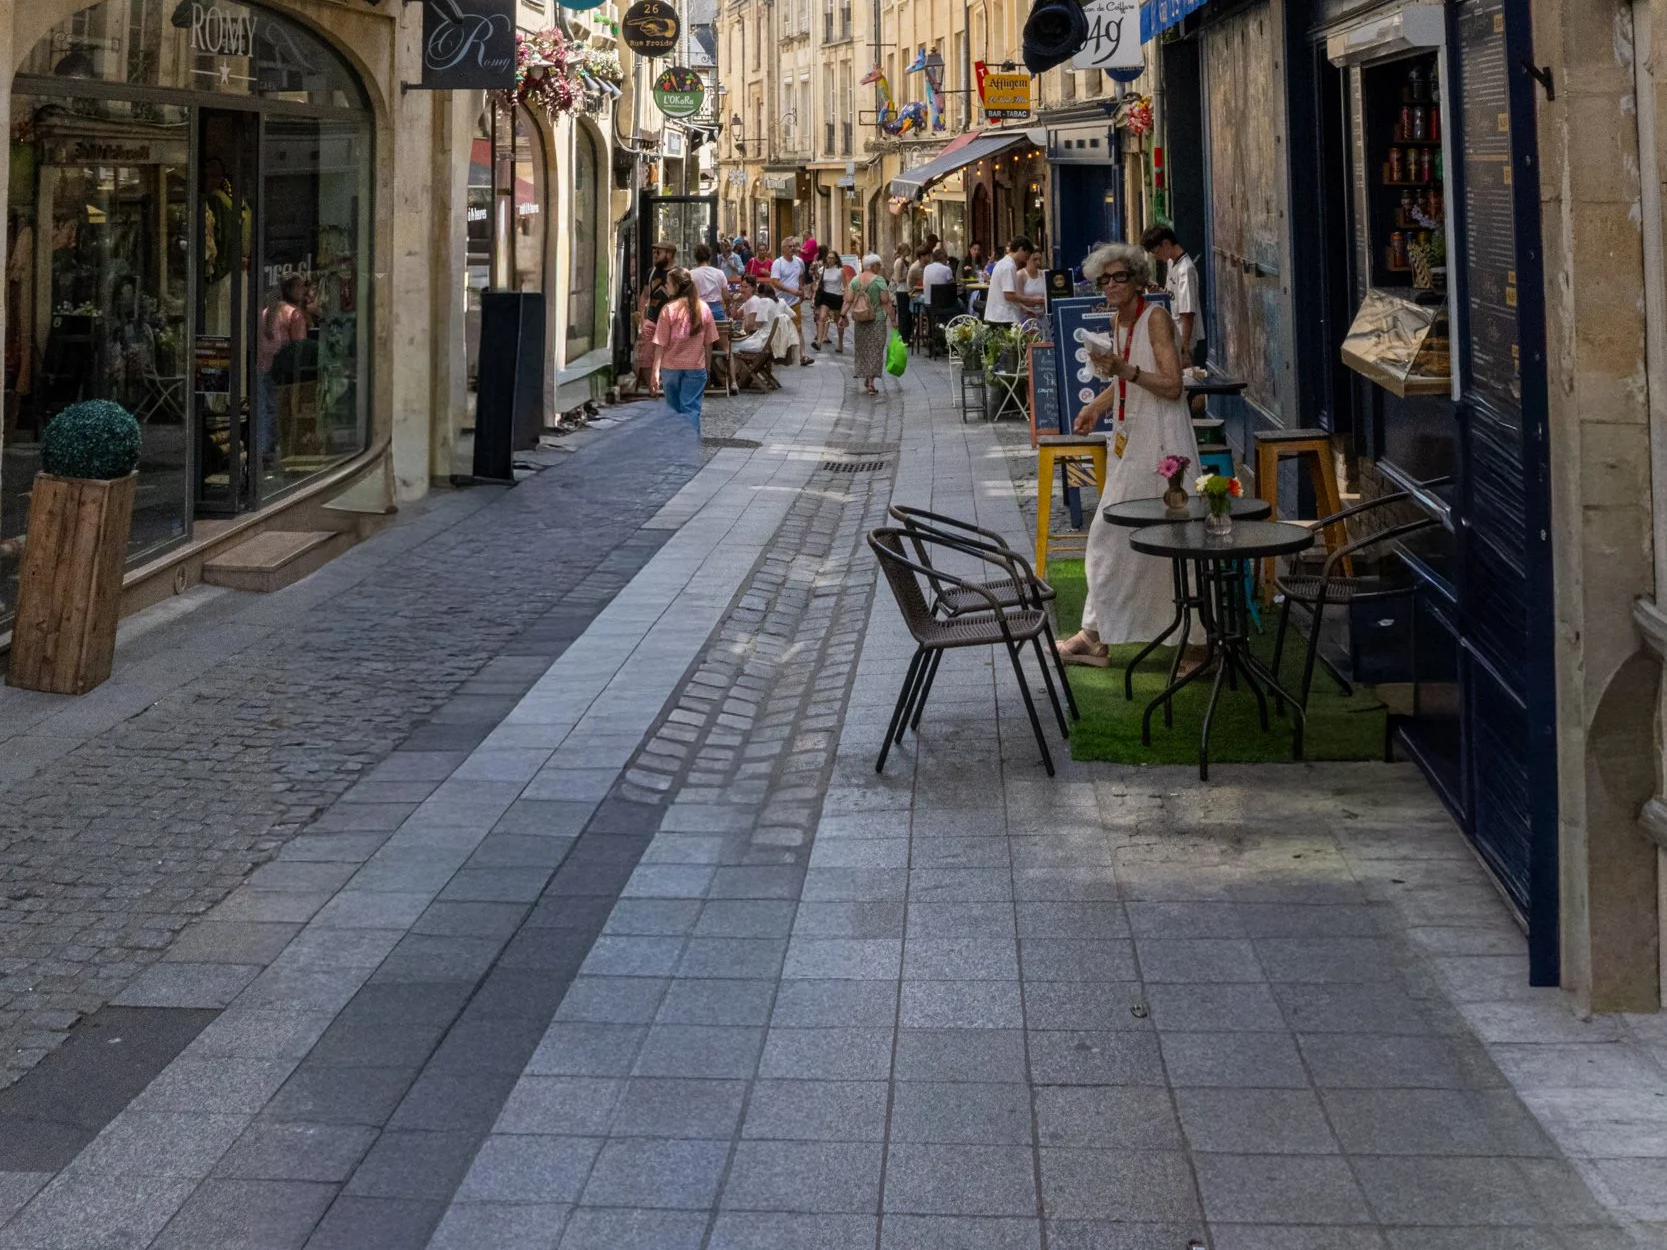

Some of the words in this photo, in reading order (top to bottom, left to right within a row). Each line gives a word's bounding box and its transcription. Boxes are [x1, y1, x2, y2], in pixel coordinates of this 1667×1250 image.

[643, 3, 660, 14] 26
[190, 2, 259, 58] ROMY
[425, 13, 511, 74] Romy
[629, 39, 644, 47] Rue
[646, 39, 674, 47] Froide
[988, 78, 1028, 91] Affligem
[988, 110, 1002, 118] BAR
[1006, 110, 1027, 118] TABAC
